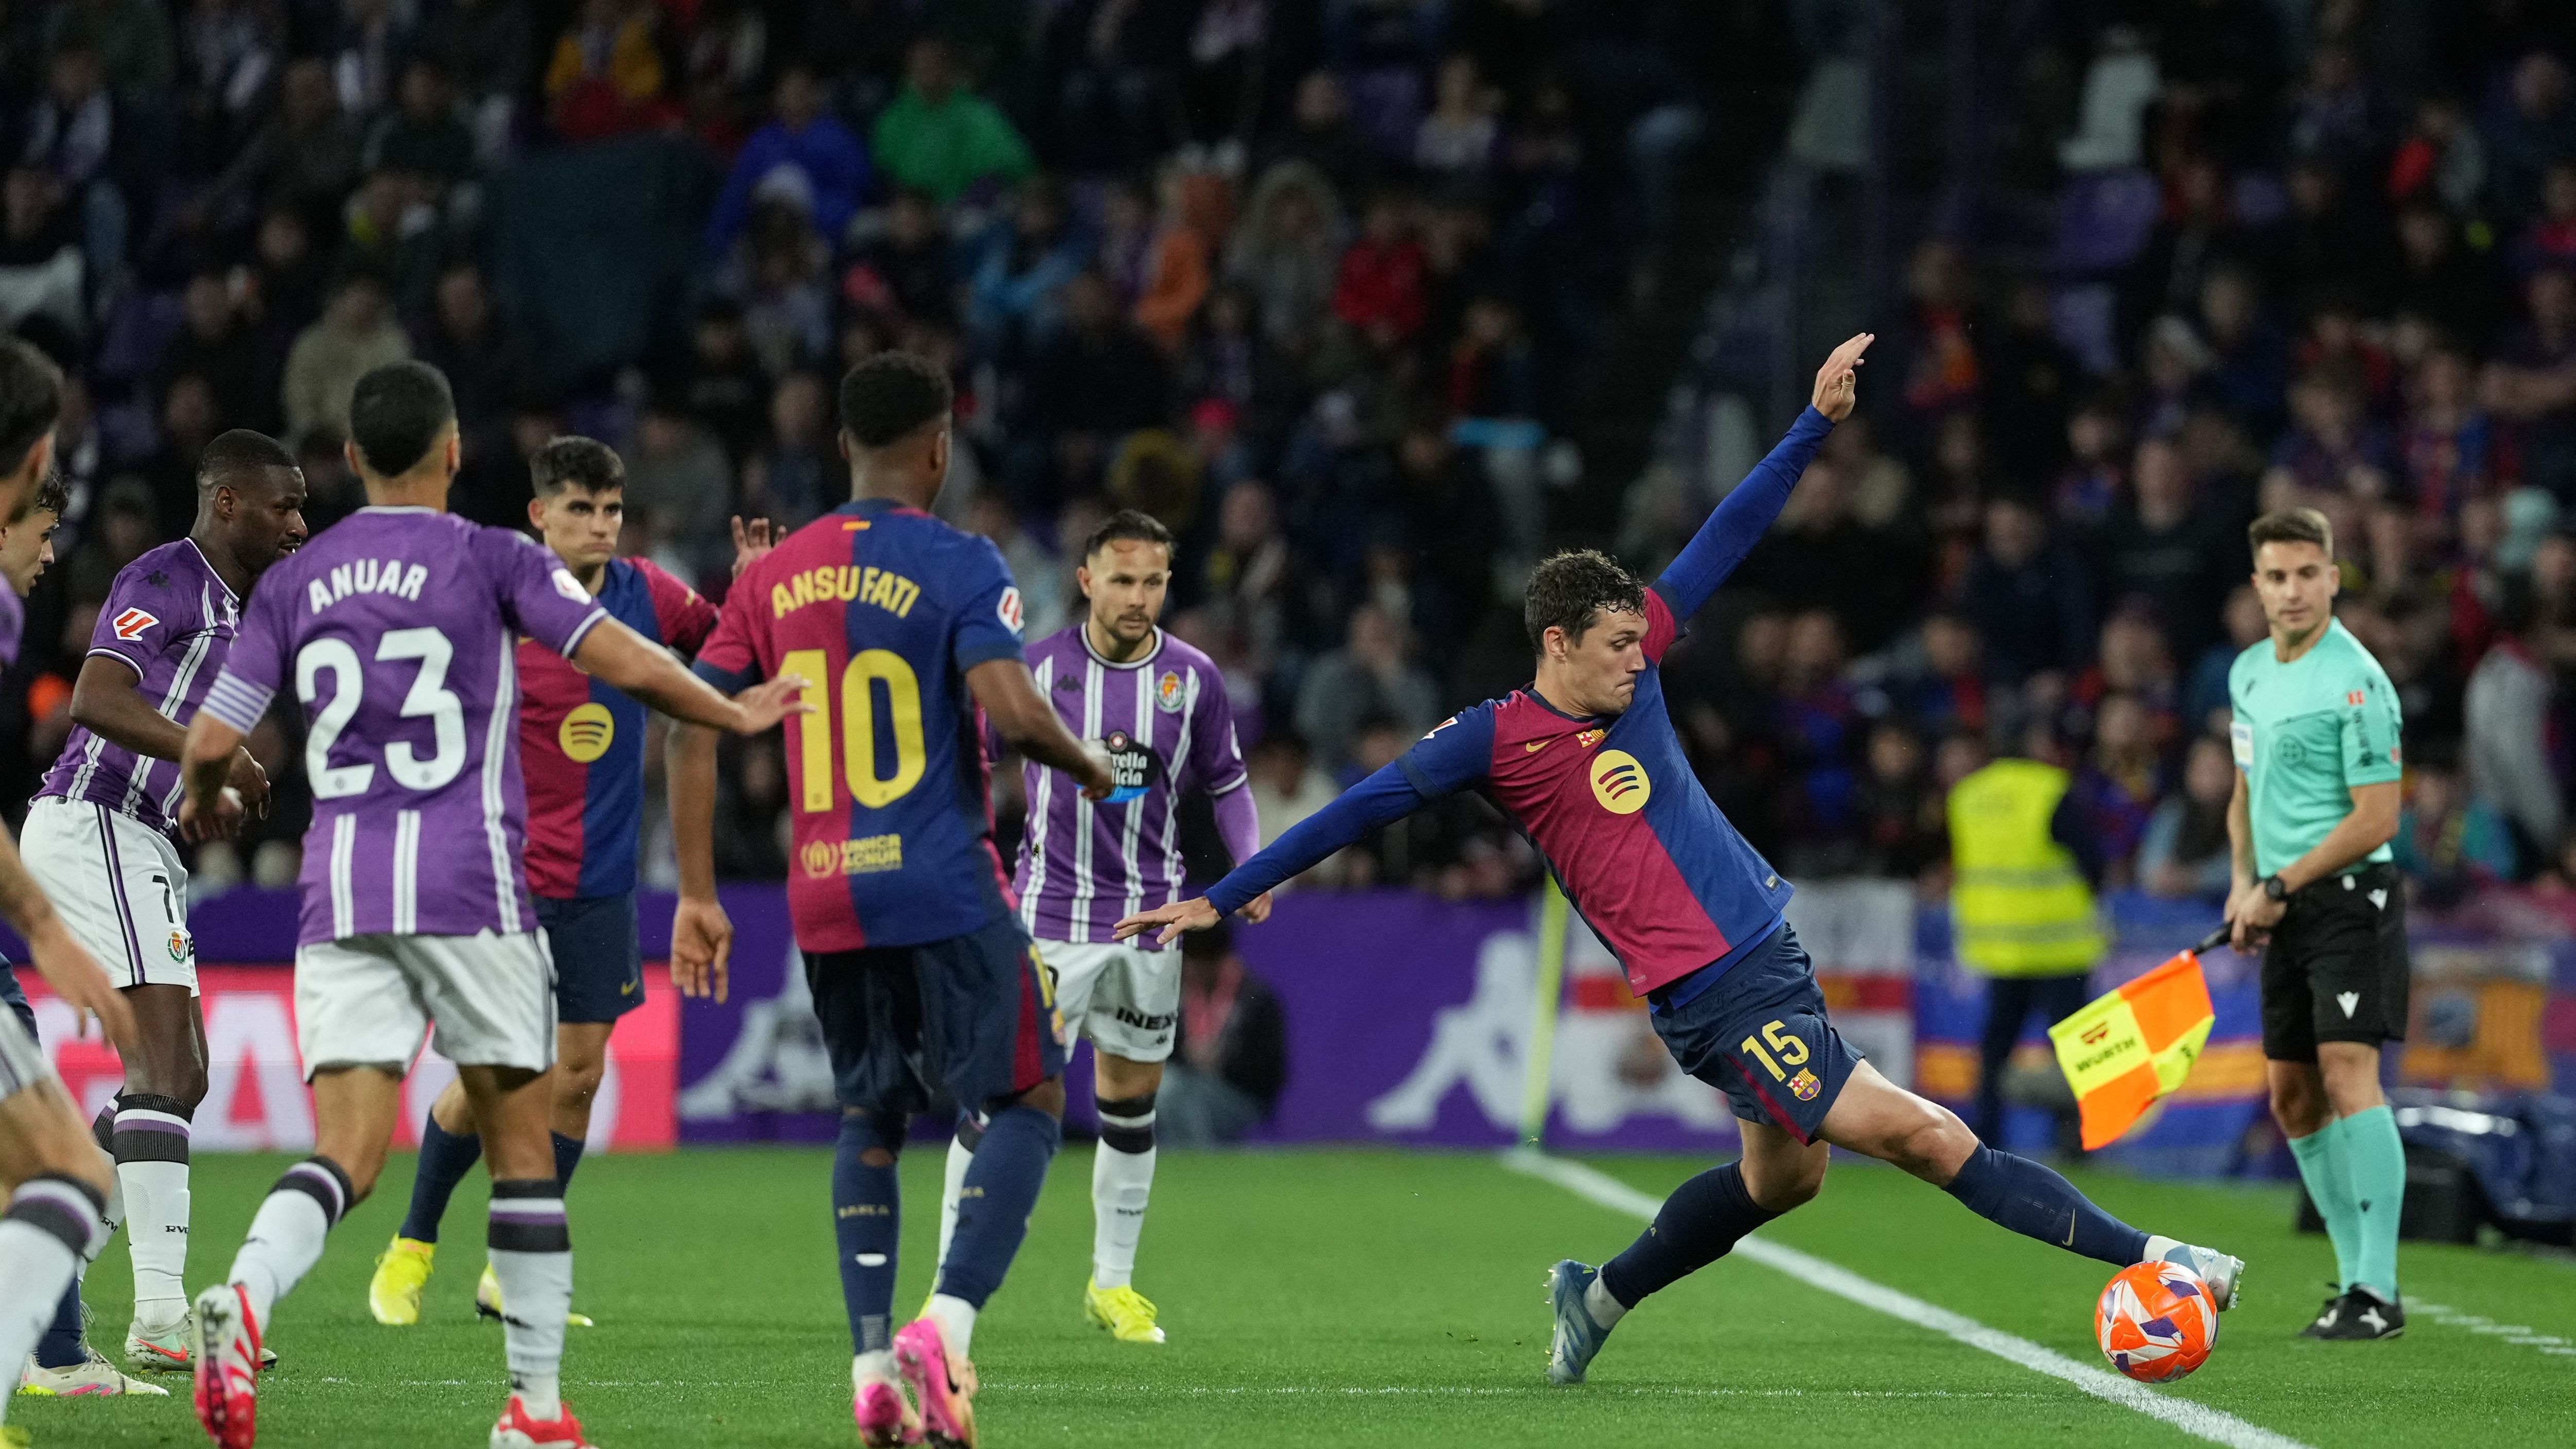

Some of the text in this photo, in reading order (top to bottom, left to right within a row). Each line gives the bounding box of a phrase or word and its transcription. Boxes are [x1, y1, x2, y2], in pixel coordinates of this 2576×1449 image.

[308, 558, 428, 614] ANUAR
[772, 566, 920, 619] ANSU FATI
[296, 626, 466, 799] 23
[779, 649, 926, 813] 10
[1111, 751, 1147, 770] rella
[152, 875, 175, 923] 7
[1742, 1020, 1809, 1082] 15
[101, 1217, 118, 1232] RV
